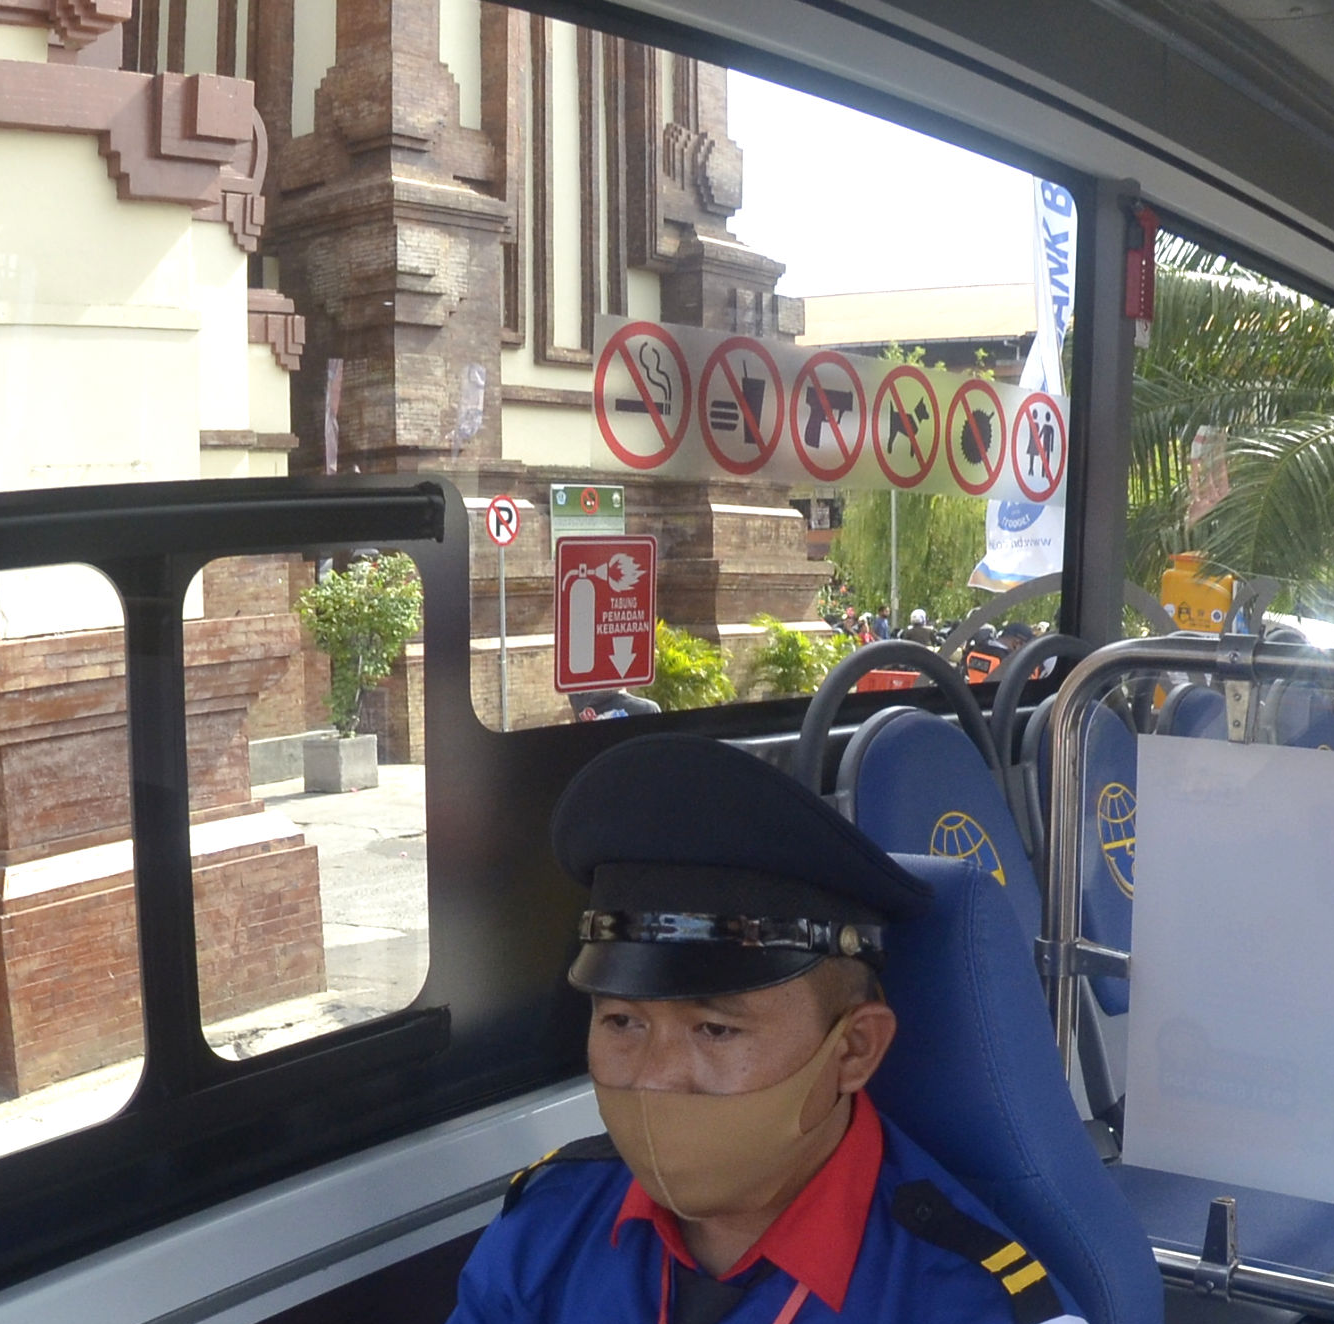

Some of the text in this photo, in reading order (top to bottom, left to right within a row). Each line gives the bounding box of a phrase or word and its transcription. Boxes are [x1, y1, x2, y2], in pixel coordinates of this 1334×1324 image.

[1043, 215, 1070, 347] ANK
[611, 597, 638, 609] TABUNG
[602, 610, 645, 623] PEMADAM
[596, 621, 650, 635] KEBAKARAN
